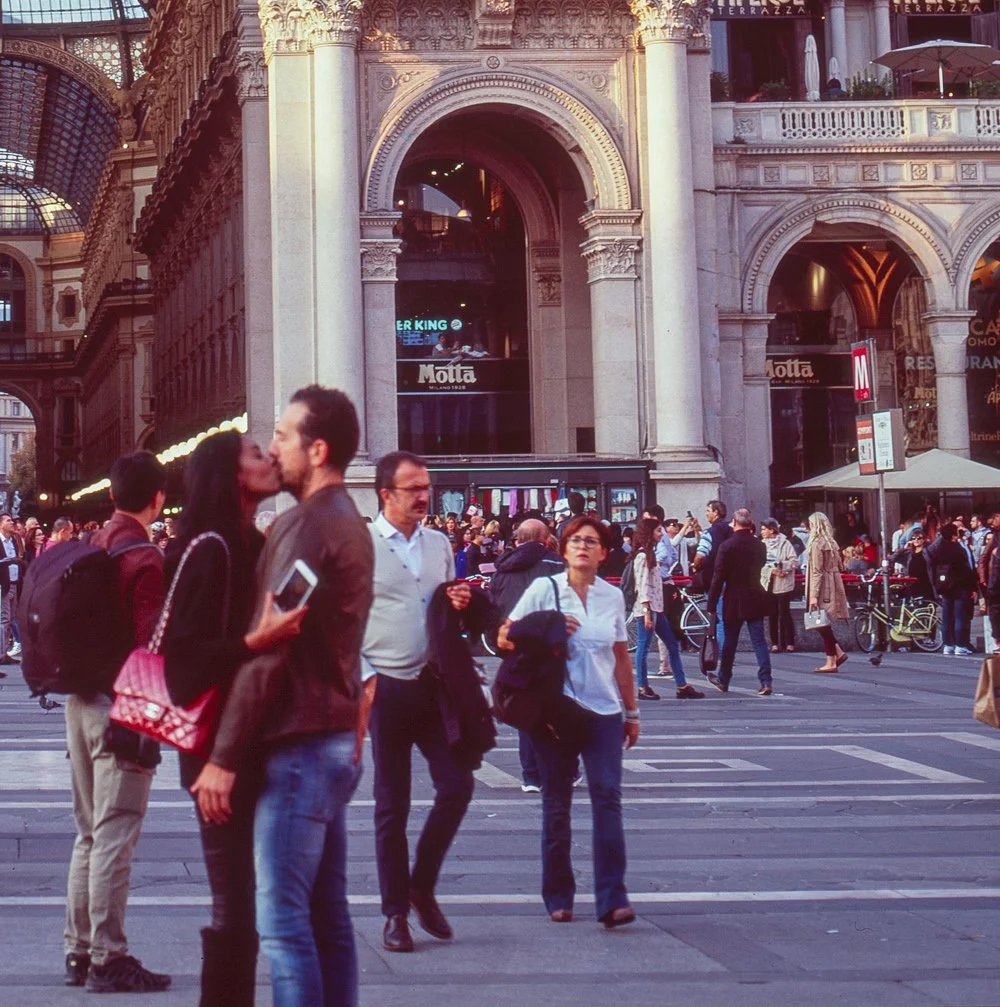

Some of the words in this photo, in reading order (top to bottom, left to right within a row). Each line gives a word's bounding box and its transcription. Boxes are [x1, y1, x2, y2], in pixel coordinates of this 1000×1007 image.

[718, 7, 805, 15] TERRAZZA
[893, 4, 981, 12] TERRAZZA
[414, 320, 448, 331] KING
[418, 363, 477, 383] Motta
[854, 354, 869, 390] M
[914, 387, 937, 399] Mot
